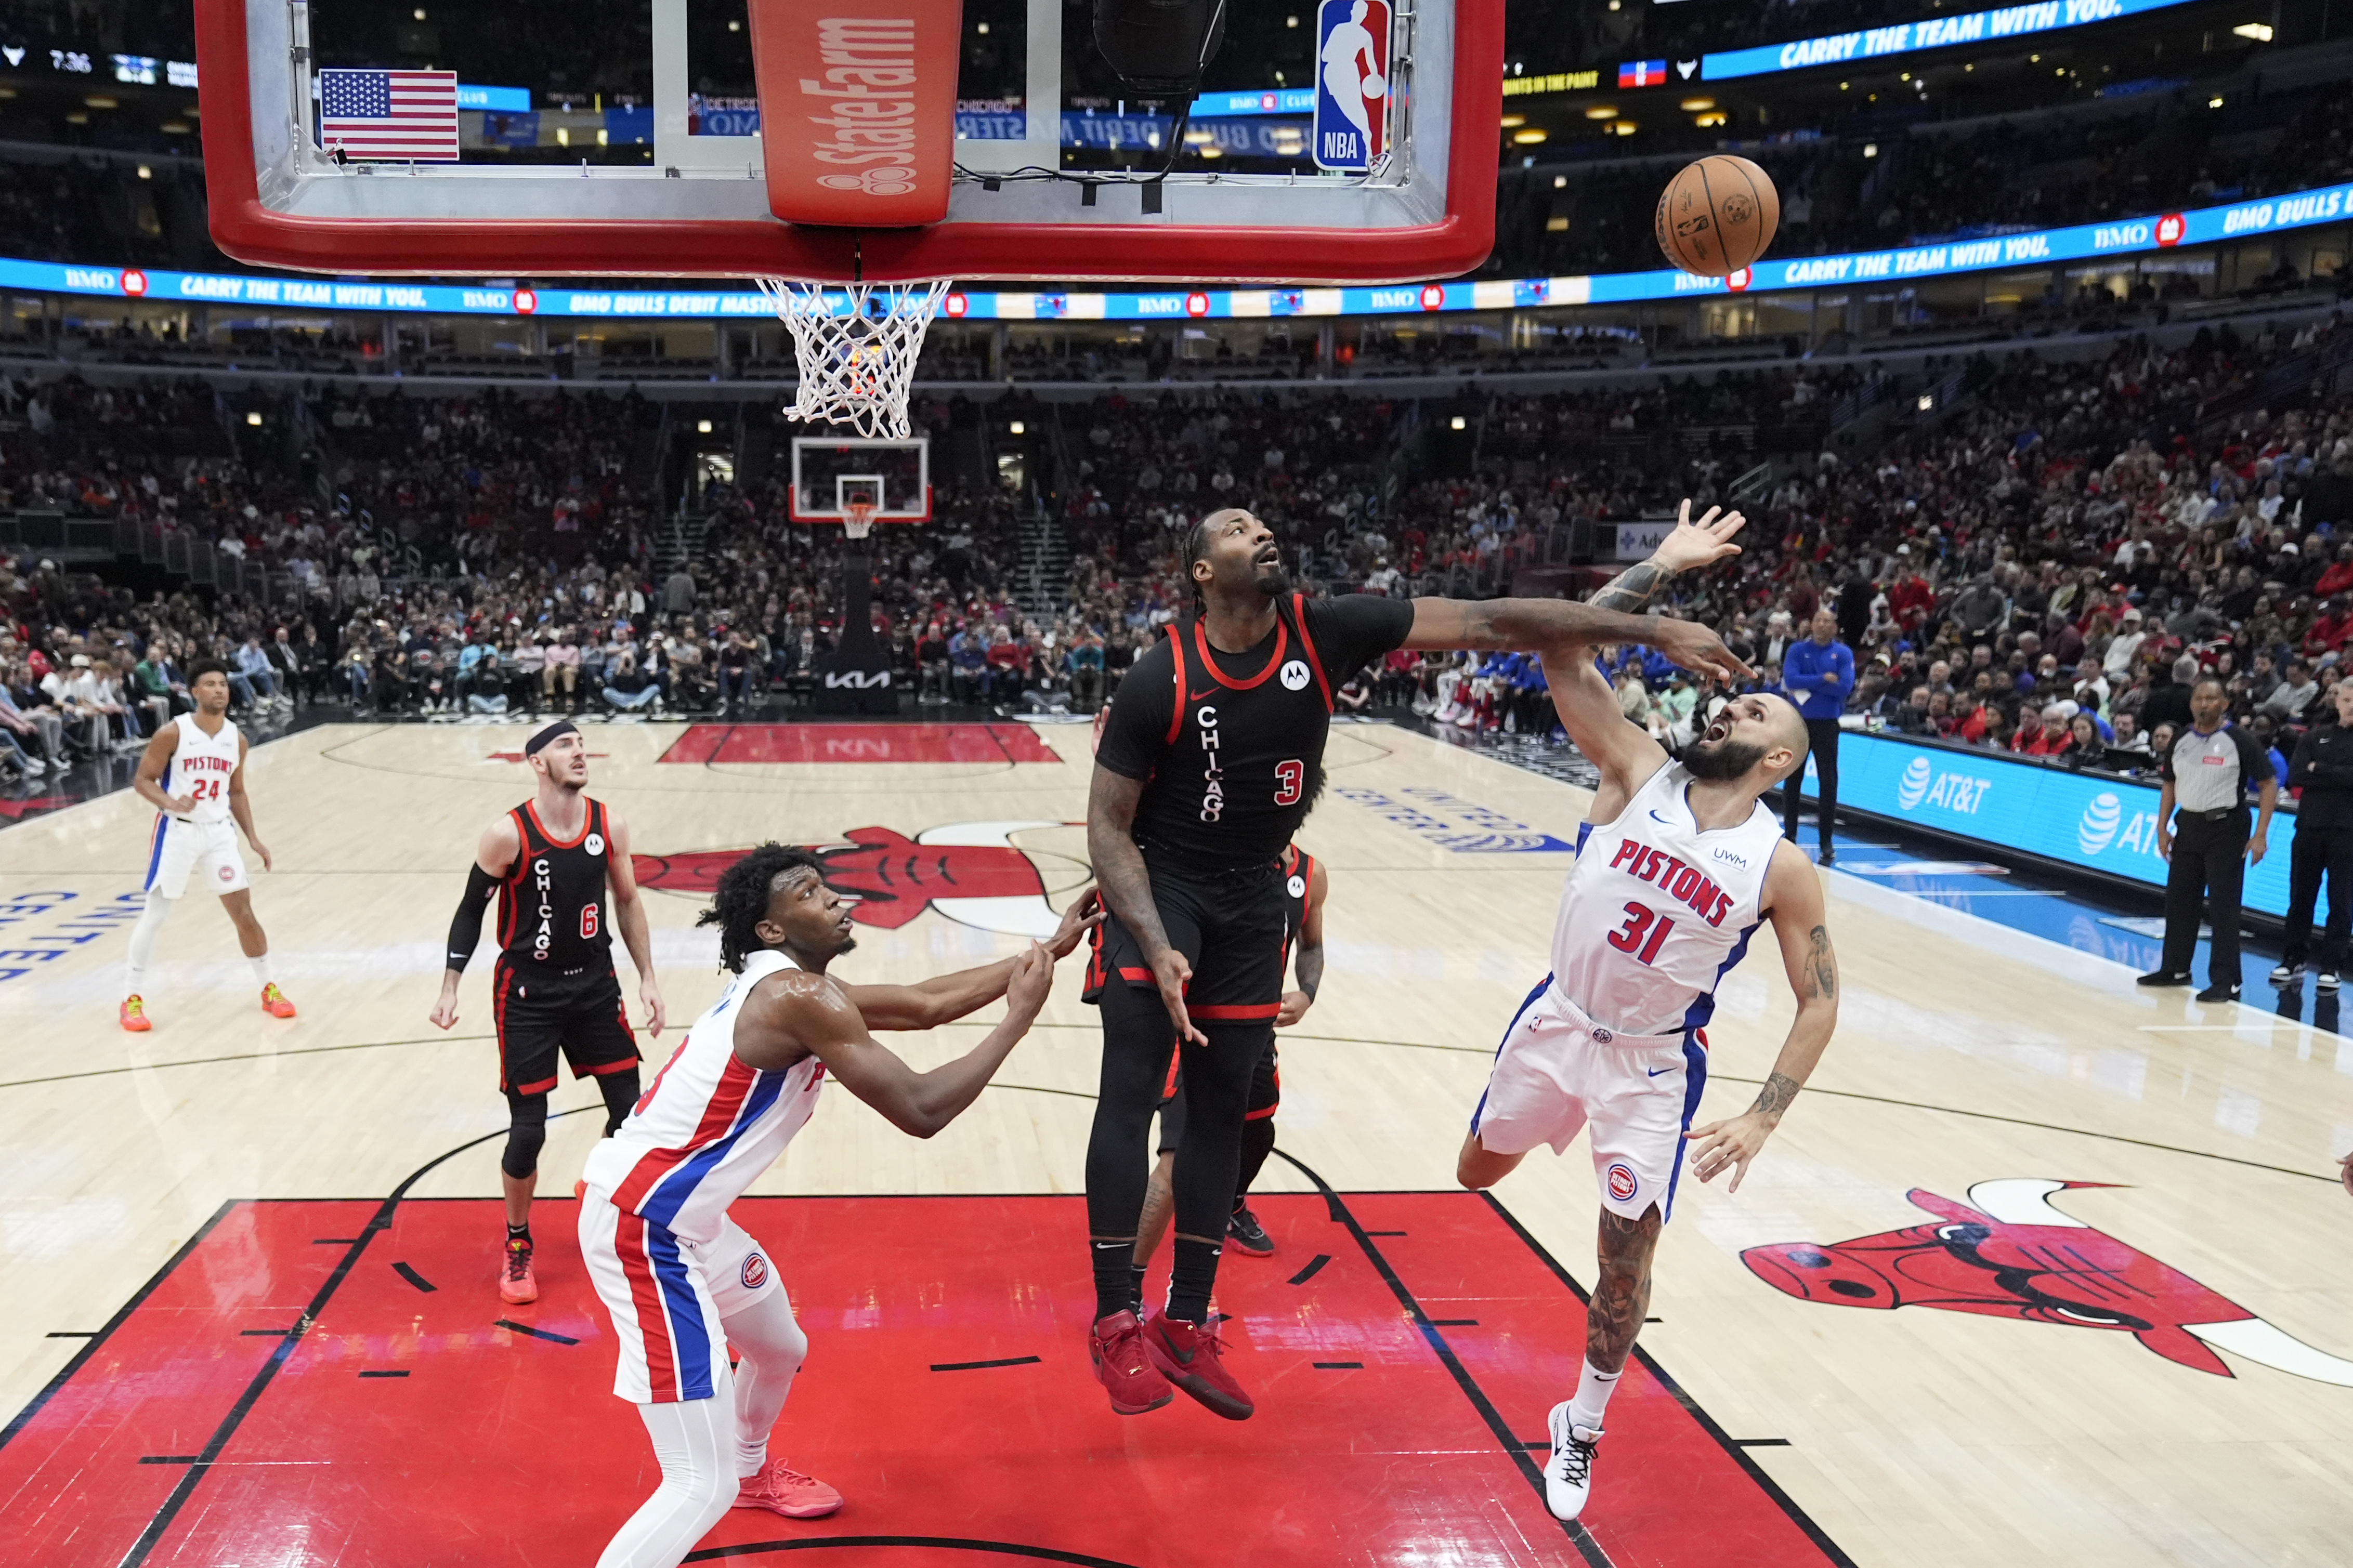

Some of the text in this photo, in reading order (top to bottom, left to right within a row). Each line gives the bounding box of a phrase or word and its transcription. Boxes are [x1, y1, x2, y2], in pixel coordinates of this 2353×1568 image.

[1780, 0, 2122, 69] CARRY THE TEAM WITH YOU.
[1324, 132, 1357, 159] NBA
[2223, 203, 2272, 233] BMO
[2274, 191, 2343, 226] BULLS
[2094, 223, 2148, 248] BMO
[1785, 234, 2050, 283] CARRY THE TEAM WITH YOU.
[64, 269, 115, 289] BMO
[180, 275, 427, 307] CARRY THE TEAM WITH YOU.
[463, 291, 507, 308] BMO
[569, 294, 611, 312] BMO
[613, 295, 666, 313] BULLS
[668, 295, 719, 313] DEBIT
[1138, 296, 1181, 314] BMO
[1371, 290, 1415, 308] BMO
[826, 670, 891, 689] KIA
[183, 756, 233, 774] PISTONS
[1197, 706, 1224, 822] CHICAGO
[193, 779, 219, 801] 24
[1274, 759, 1303, 806] 3
[1926, 771, 1991, 814] AT&T
[1714, 847, 1746, 868] UWM
[1609, 838, 1734, 928] PISTONS
[533, 859, 553, 960] CHICAGO
[579, 902, 598, 939] 6
[1607, 901, 1675, 966] 31
